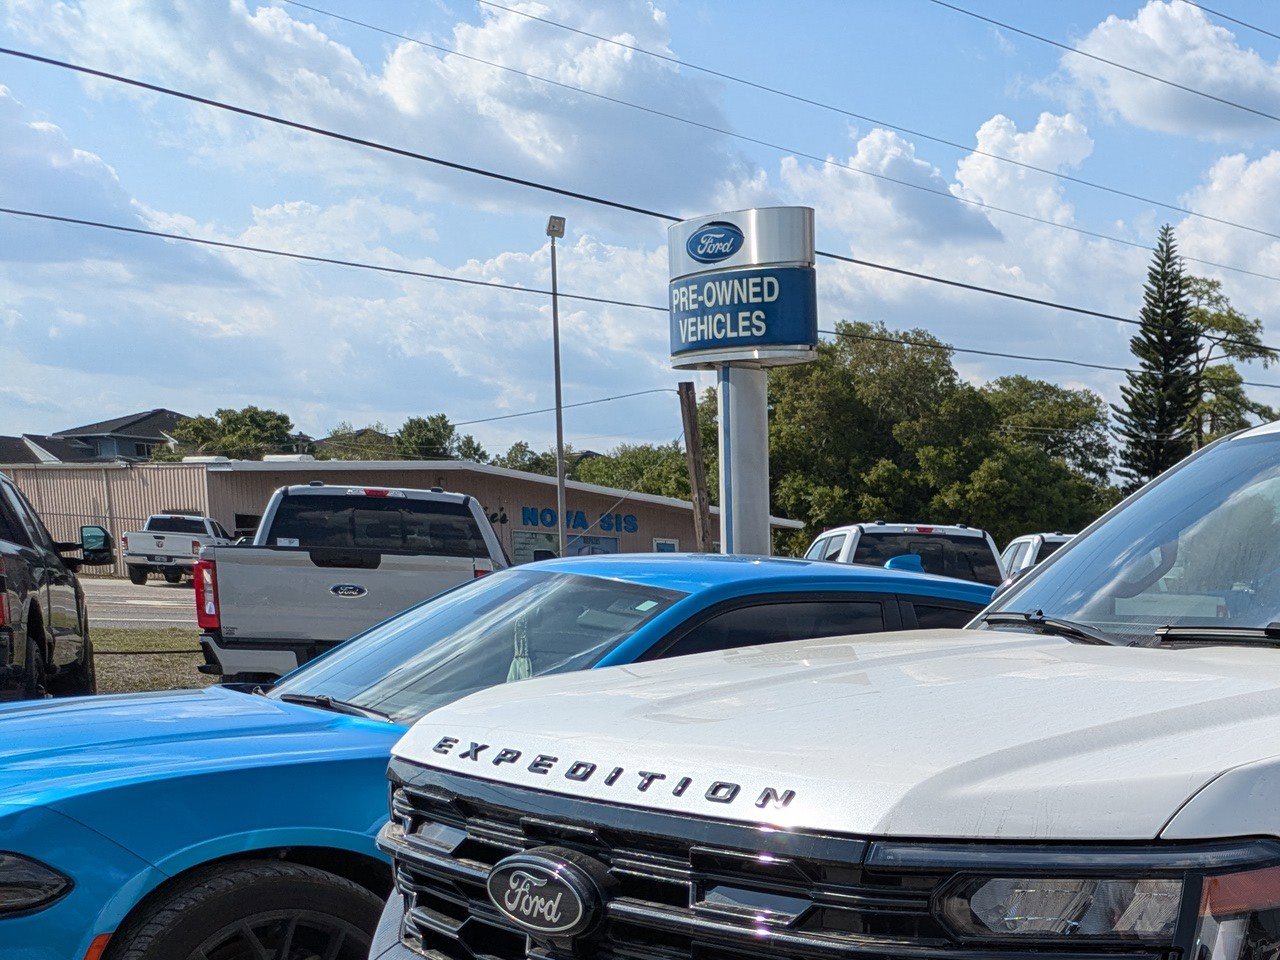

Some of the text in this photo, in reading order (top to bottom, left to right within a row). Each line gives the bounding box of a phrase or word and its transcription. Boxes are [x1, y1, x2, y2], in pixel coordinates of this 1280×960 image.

[697, 233, 734, 255] Ford
[672, 276, 780, 313] PRE-OWNED
[679, 310, 767, 344] VEHICLES
[432, 736, 797, 810] EXPEDITION
[504, 869, 563, 924] Ford
